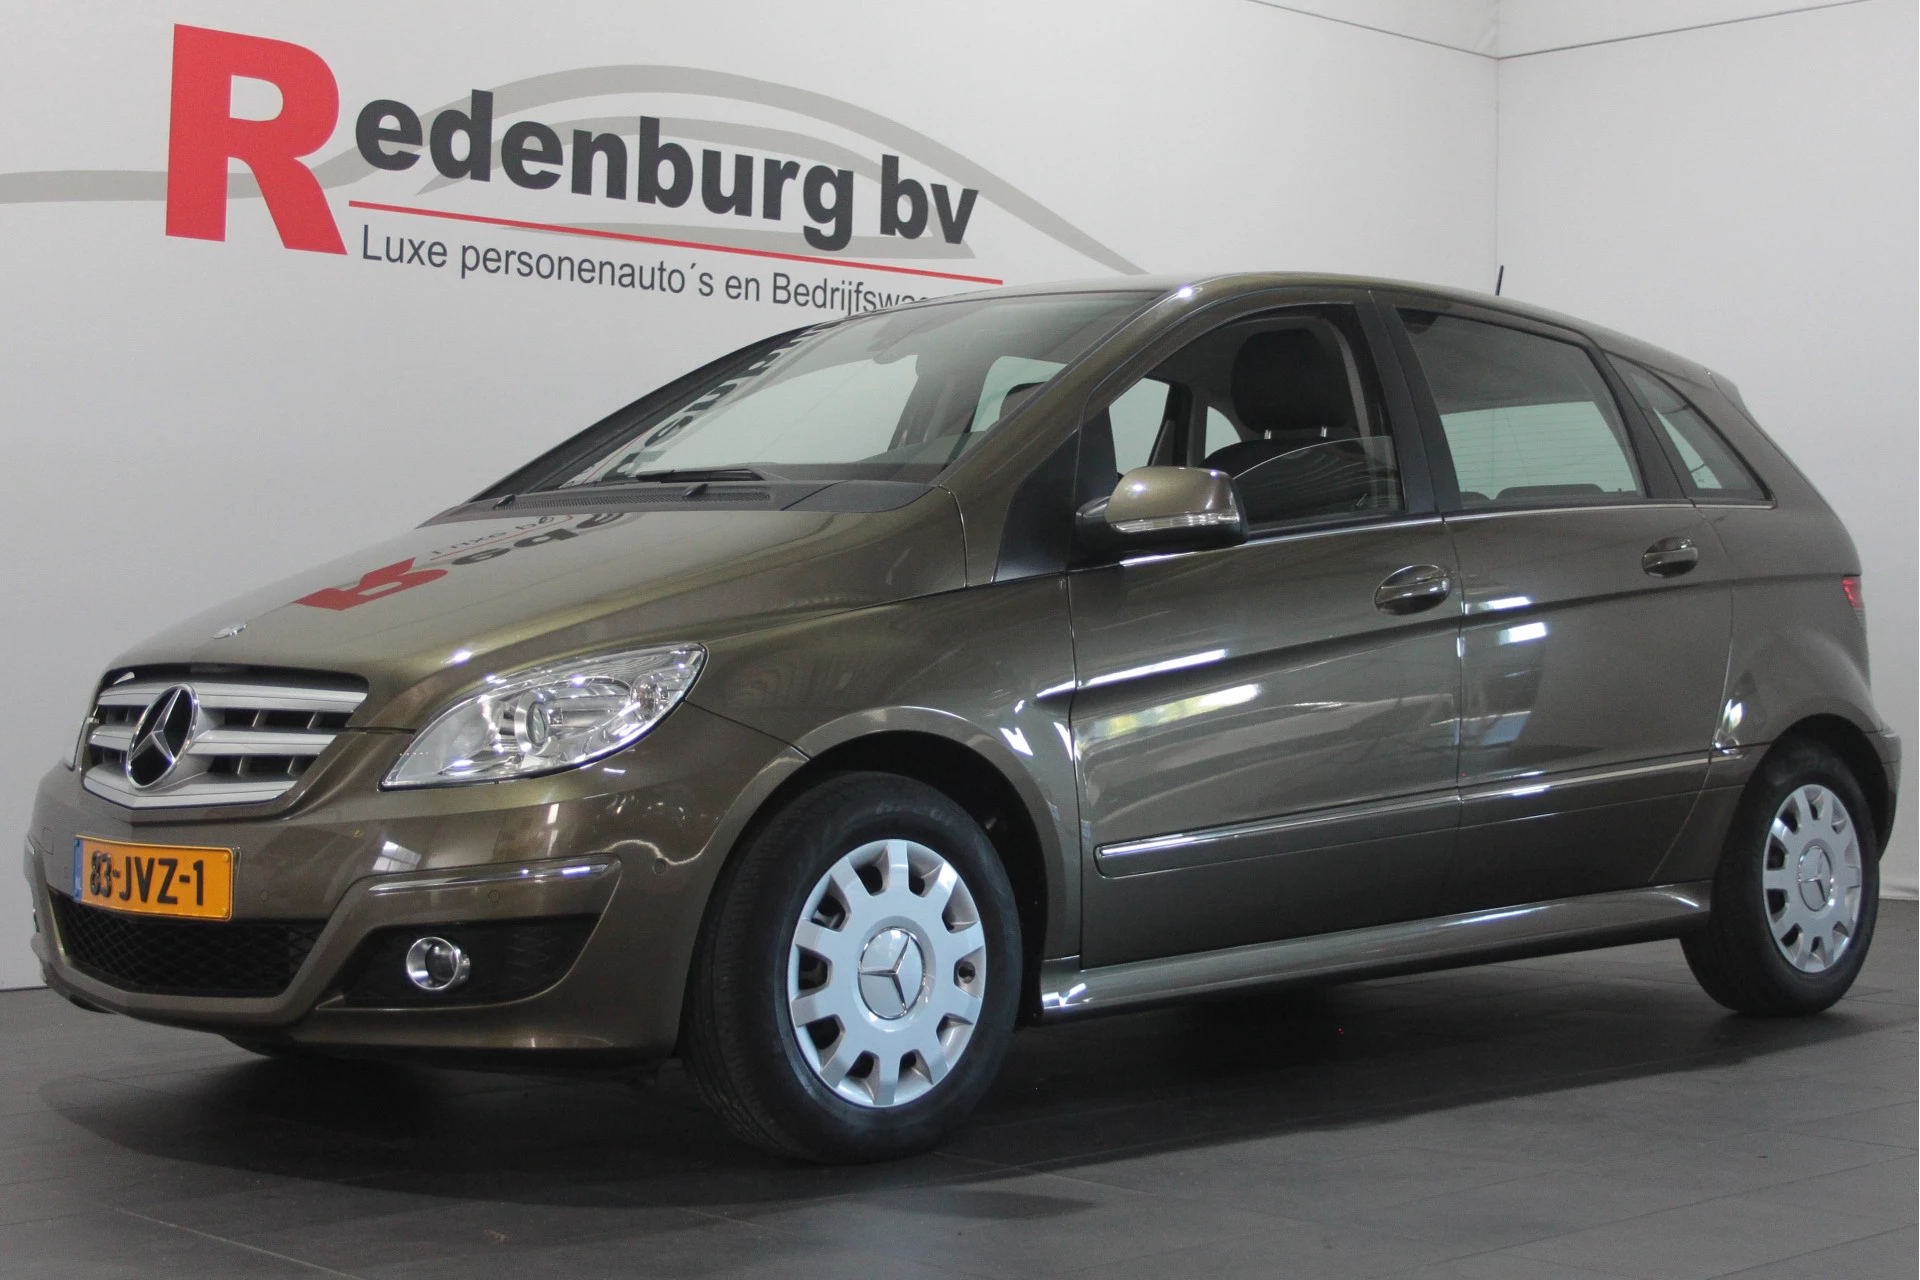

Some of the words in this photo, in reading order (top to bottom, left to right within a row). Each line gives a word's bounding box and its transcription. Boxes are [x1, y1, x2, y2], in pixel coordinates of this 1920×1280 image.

[166, 24, 854, 254] Redenburg
[880, 154, 979, 245] bv
[362, 224, 448, 268] Luxe
[725, 275, 761, 303] en
[89, 850, 204, 906] 83-JVZ-1
